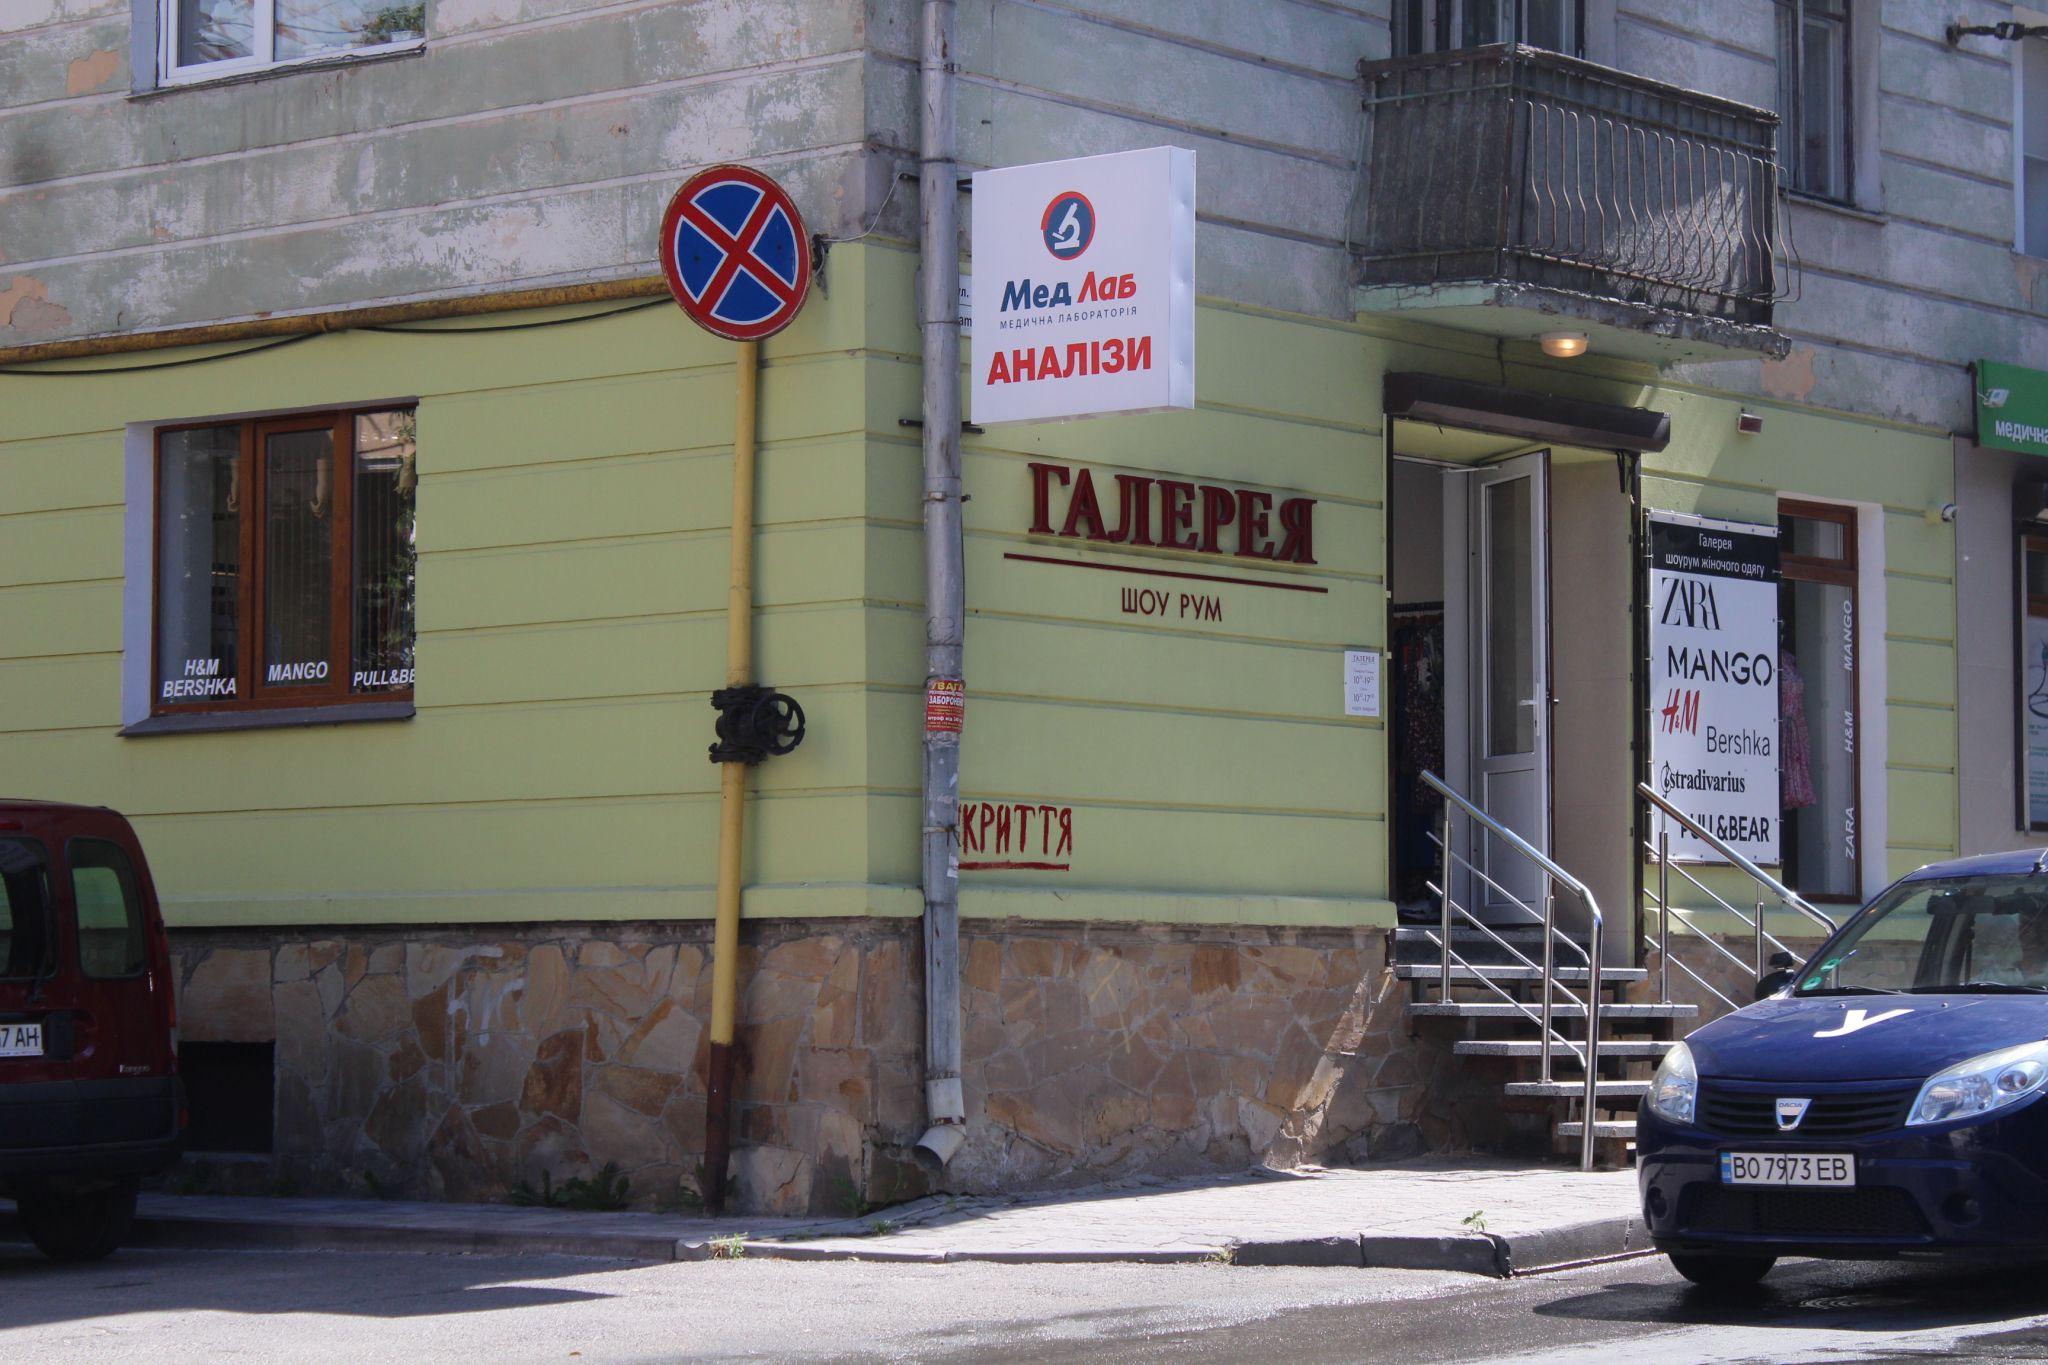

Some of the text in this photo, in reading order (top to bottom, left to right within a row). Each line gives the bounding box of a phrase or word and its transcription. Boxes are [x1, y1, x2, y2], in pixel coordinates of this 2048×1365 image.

[1000, 271, 1137, 312] Мед Лаб
[1000, 306, 1137, 330] МЕДИЧНА ЛАБОРАТОРІЯ
[986, 335, 1152, 386] АНАЛІЗИ
[1027, 462, 1318, 565] ГАЛЕРЕЯ
[1698, 533, 1733, 551] Галерея
[1665, 553, 1765, 579] шоурум жіночого одягу
[1121, 587, 1223, 622] ШОУ РУМ
[1661, 577, 1721, 631] ZARA
[1843, 600, 1854, 672] MANGO
[184, 658, 220, 676] H&M
[268, 661, 328, 682] MANGO
[1667, 645, 1773, 687] MANGO
[162, 677, 237, 698] BERSHKA
[1661, 688, 1700, 737] H&M
[1706, 726, 1771, 756] Bershka
[1843, 711, 1855, 753] H&M
[958, 802, 1072, 857] КРИТТЯ
[1845, 807, 1856, 860] ZARA
[15, 1027, 39, 1048] AH
[1733, 1157, 1847, 1181] BO 7973 EB
